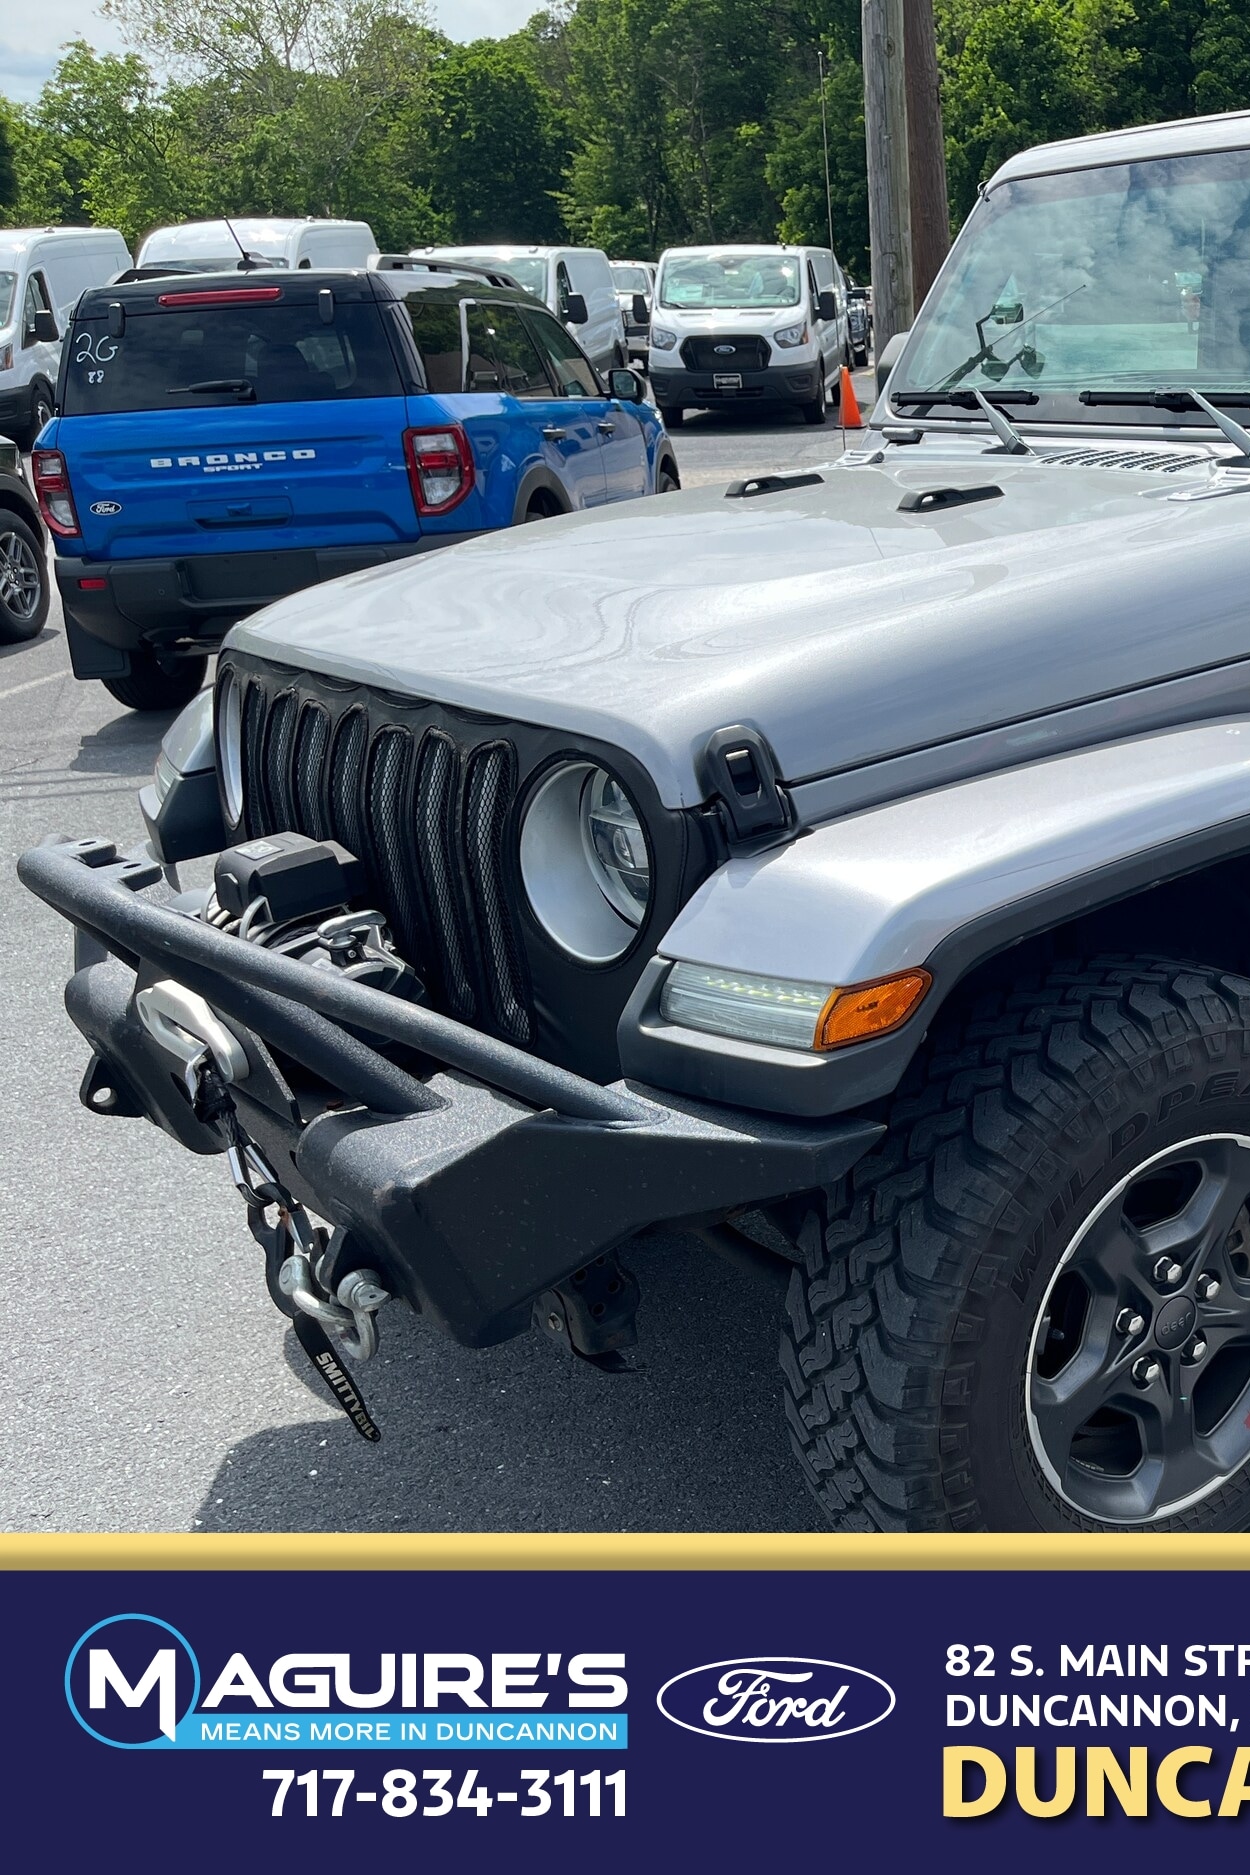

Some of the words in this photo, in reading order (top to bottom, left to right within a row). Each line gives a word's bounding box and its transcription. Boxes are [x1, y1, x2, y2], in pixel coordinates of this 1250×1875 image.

[150, 449, 316, 469] BRONCO
[203, 463, 263, 473] SPORT
[95, 503, 116, 514] Ford
[316, 1352, 375, 1439] SMITTYBIL
